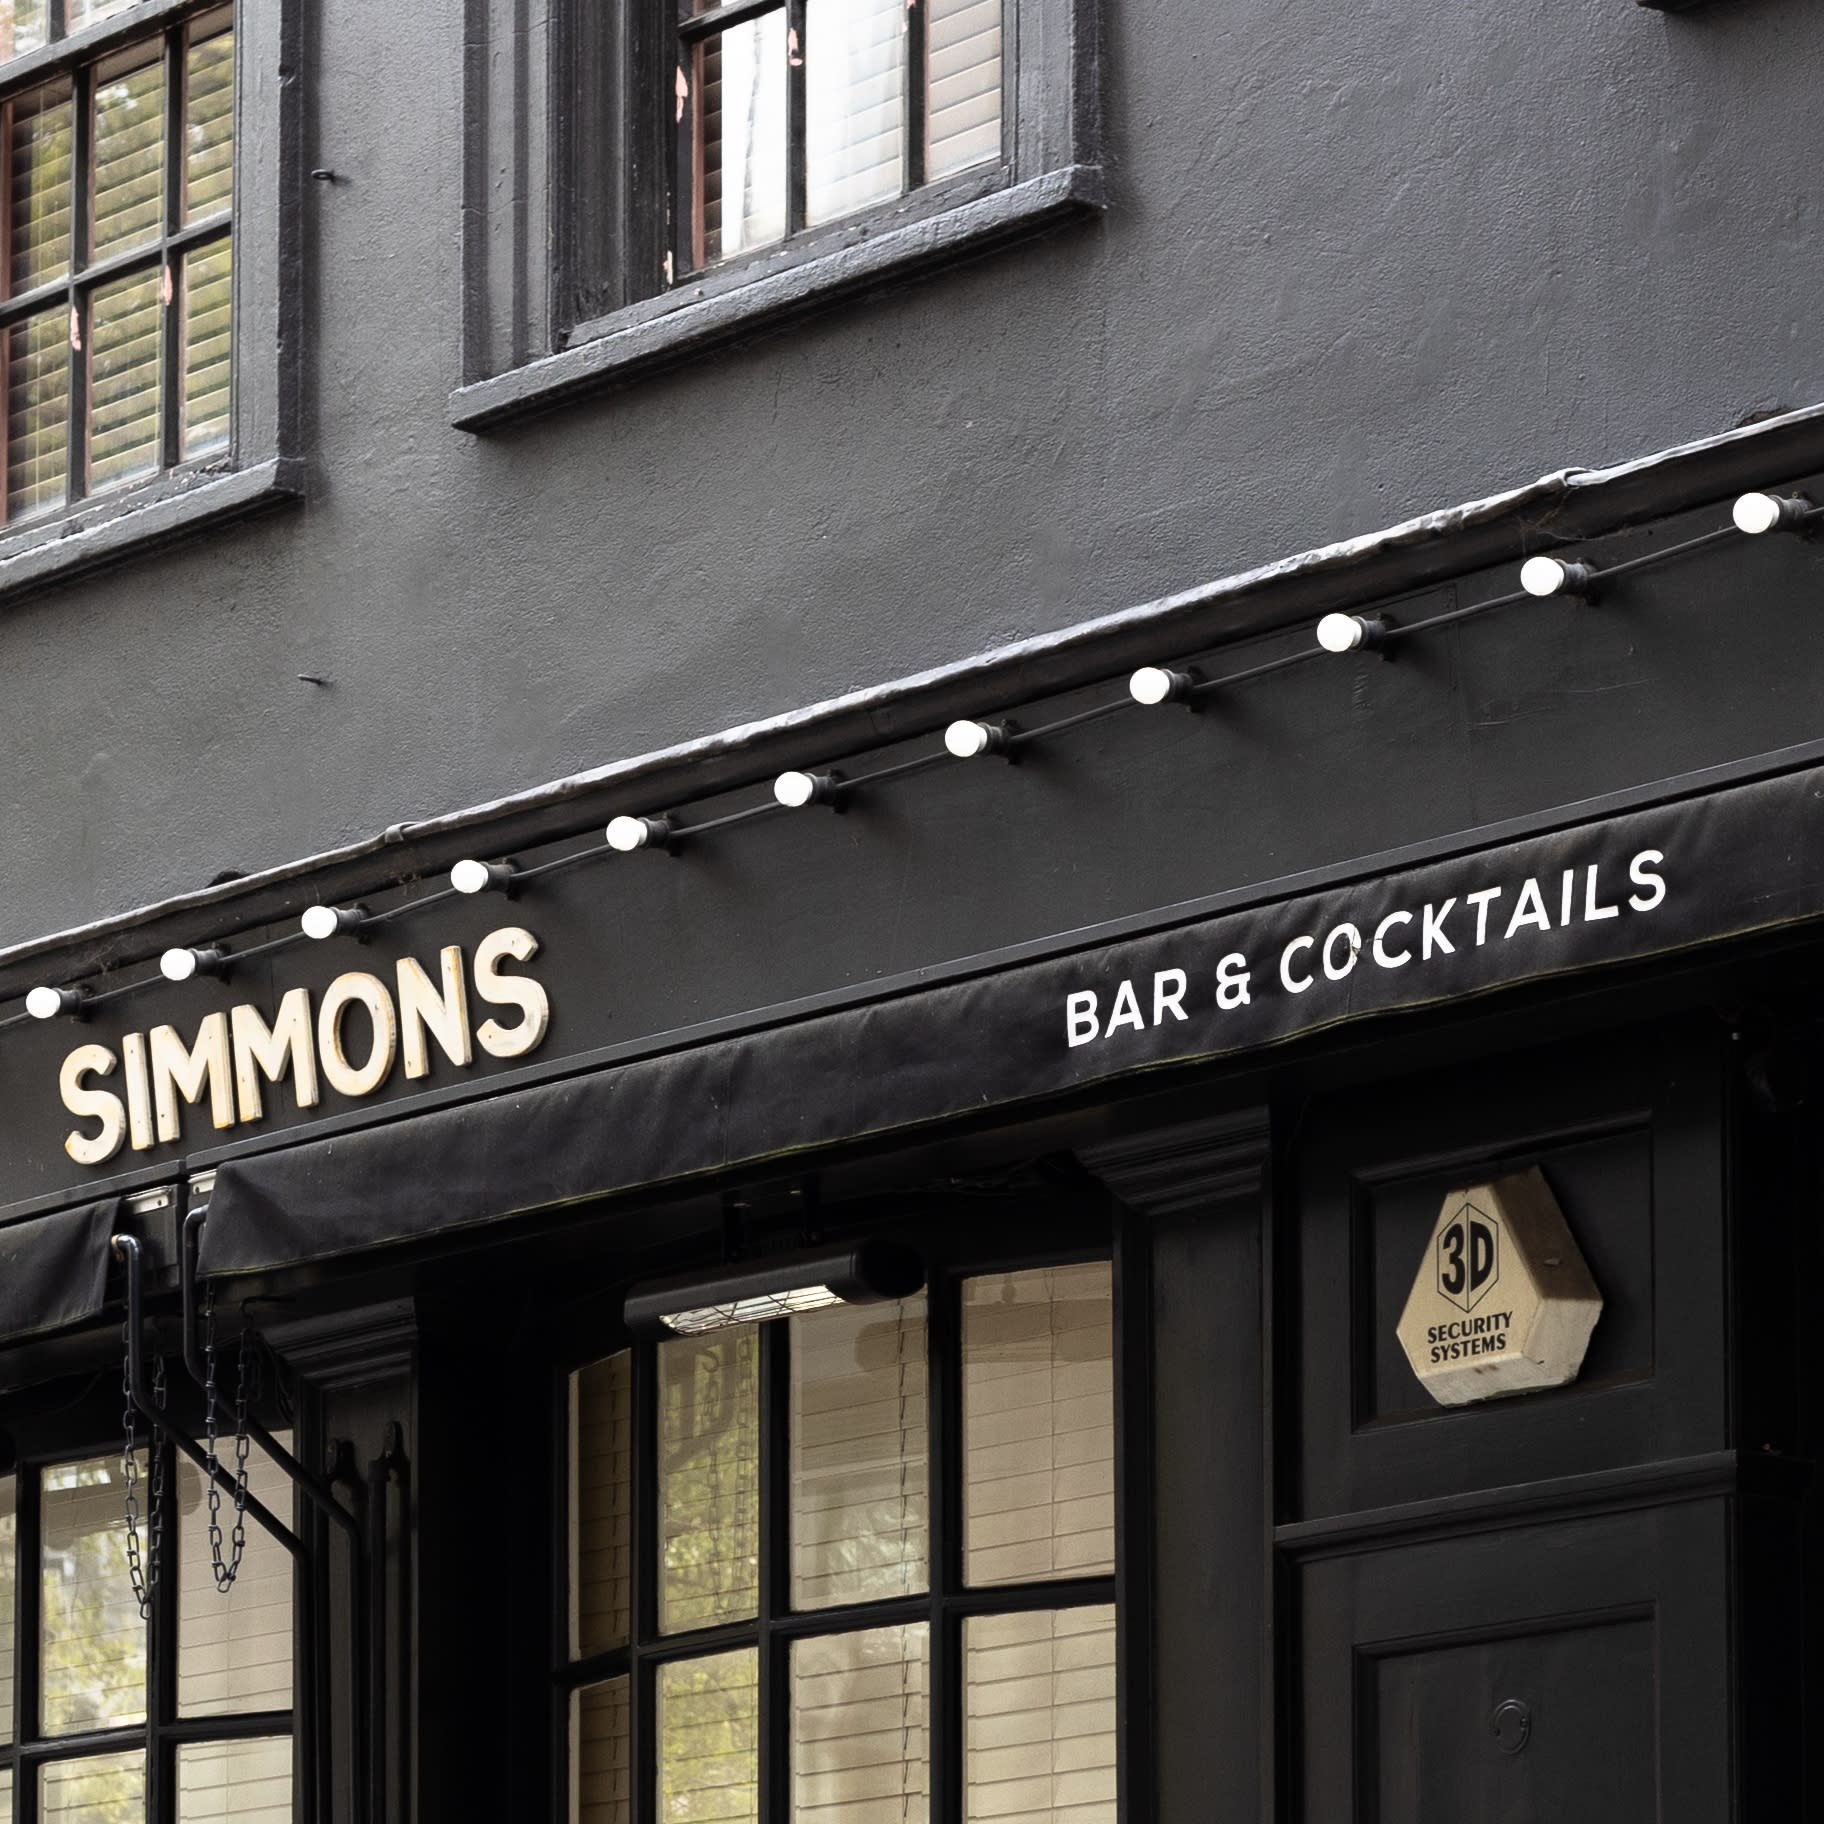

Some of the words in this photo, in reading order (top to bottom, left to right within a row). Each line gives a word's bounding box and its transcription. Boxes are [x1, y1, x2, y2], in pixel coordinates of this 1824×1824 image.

[1067, 968, 1189, 1048] BAR
[1215, 952, 1251, 1010] &
[1279, 849, 1666, 994] COCKTAILS
[59, 926, 549, 1165] SIMMONS
[1442, 1221, 1494, 1295] 3D
[1427, 1311, 1513, 1344] SECURITY
[1430, 1333, 1506, 1363] SYSTEMS
